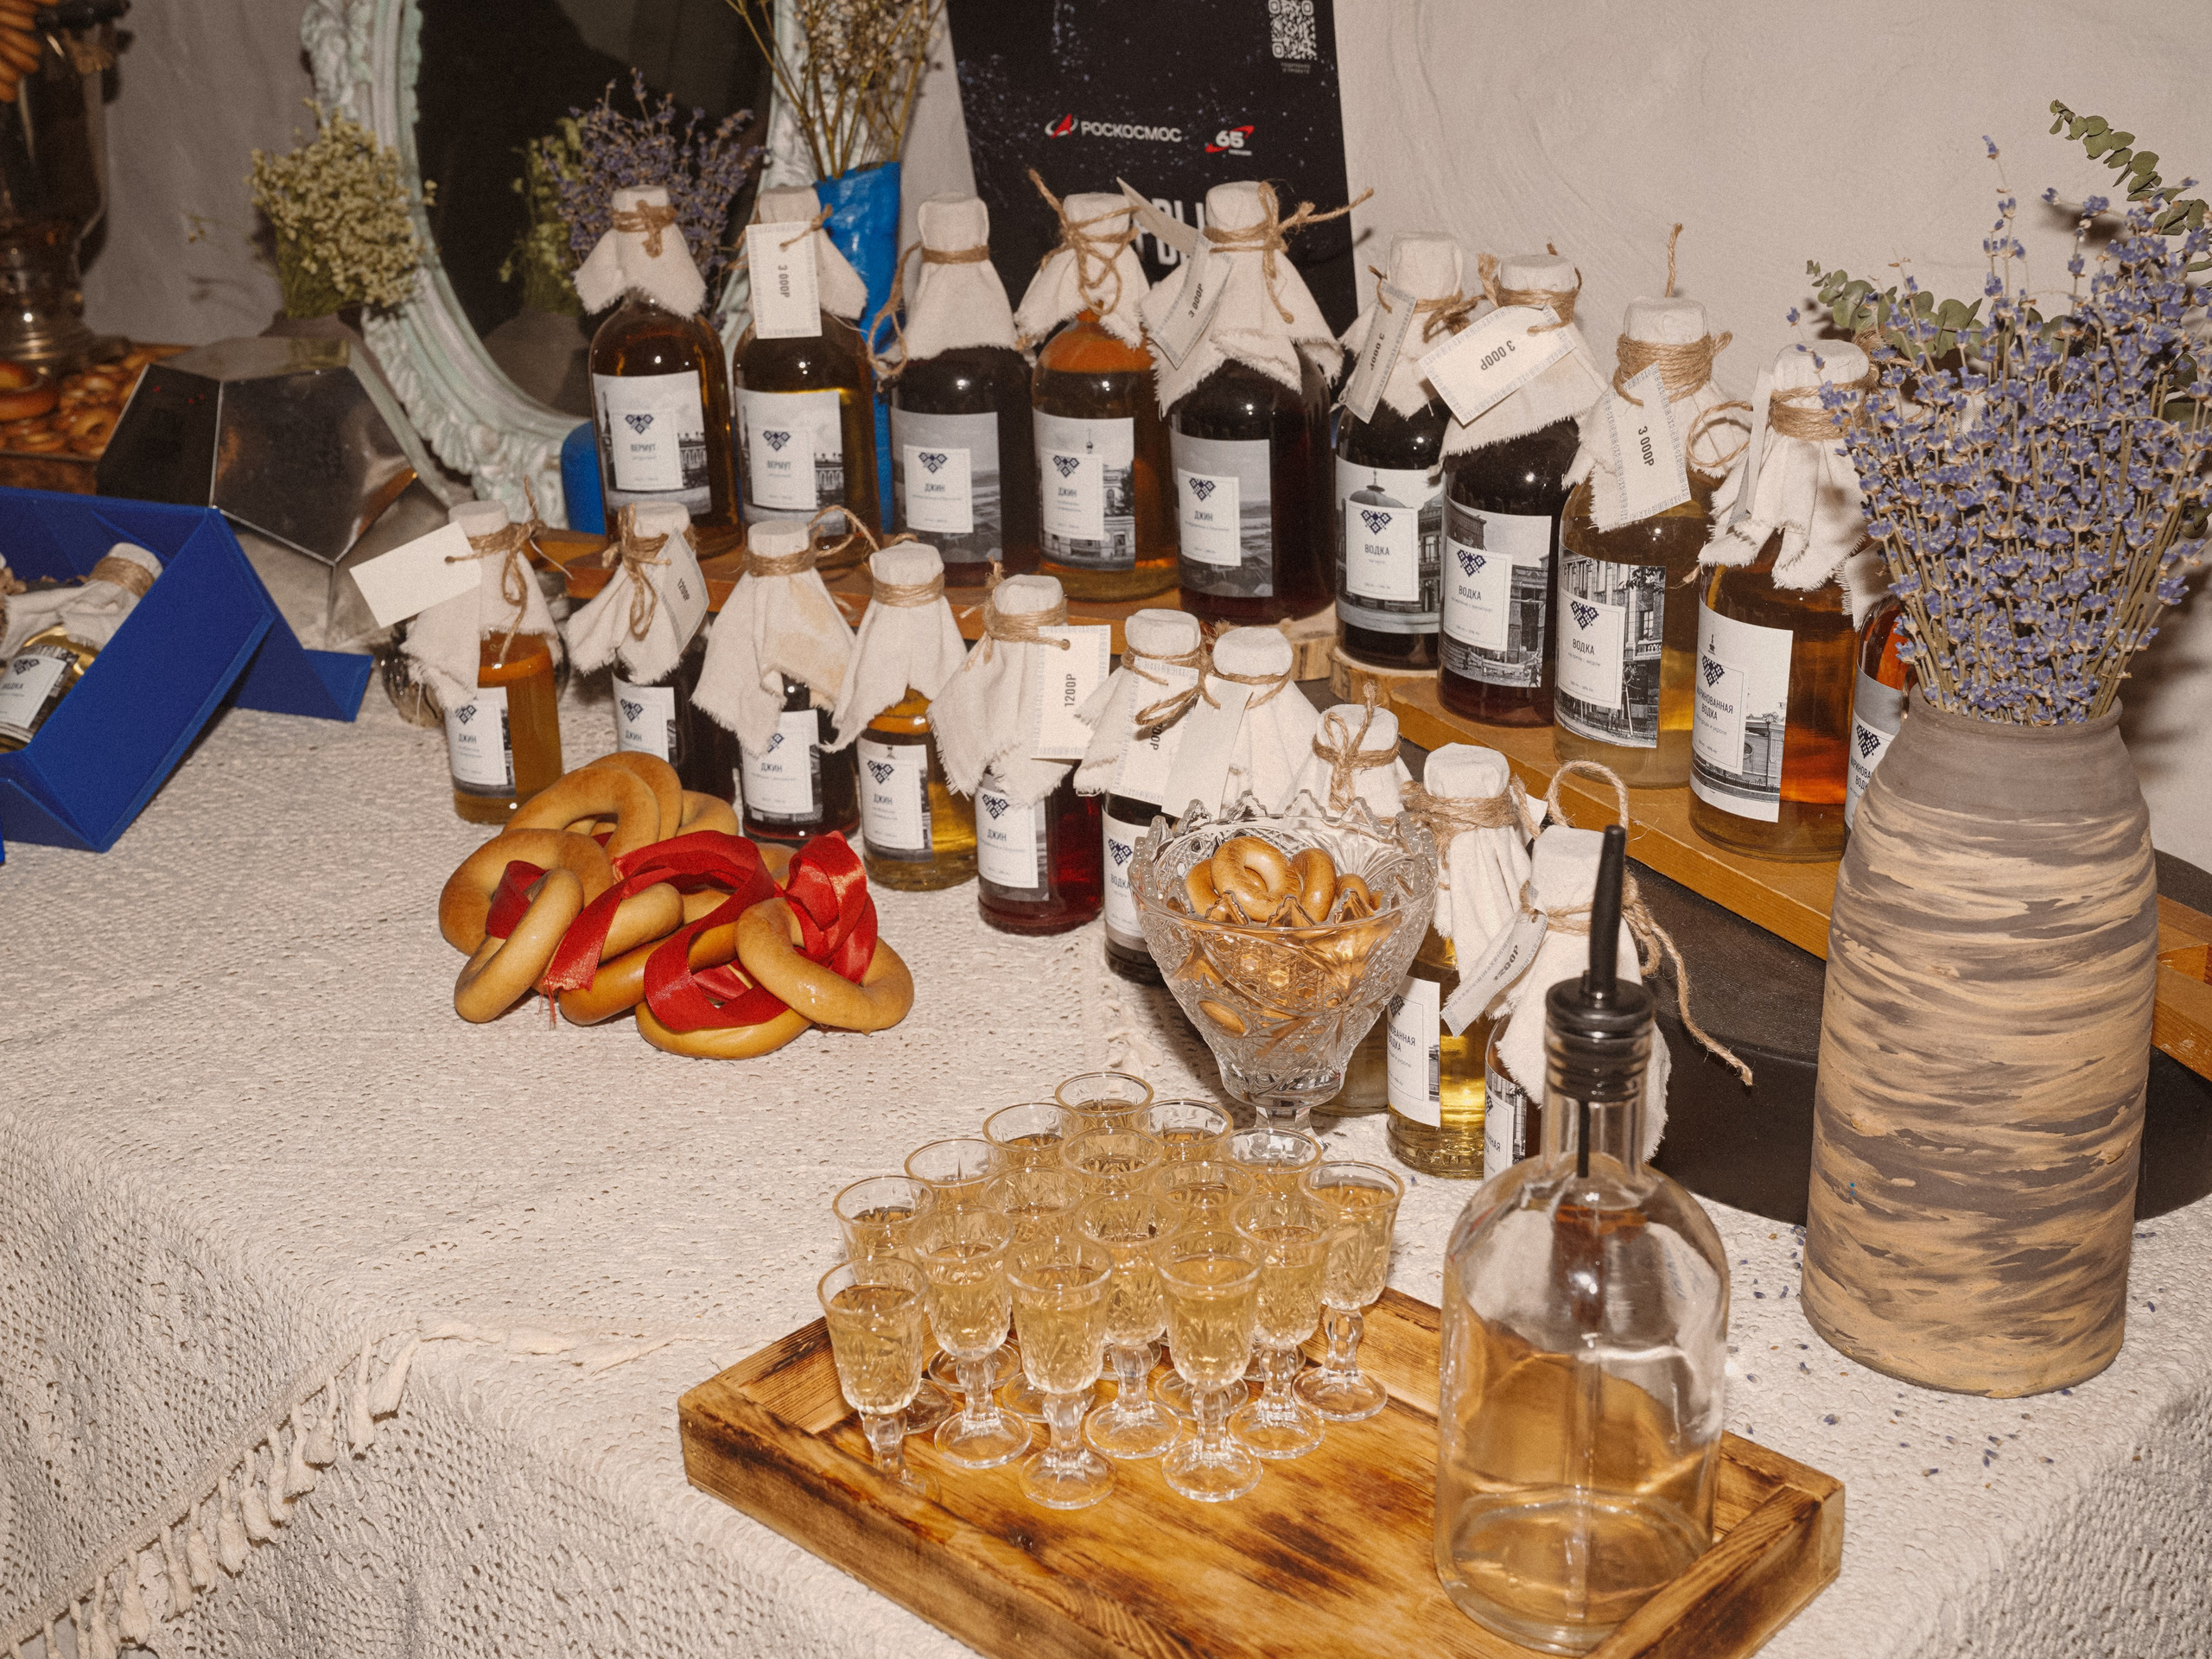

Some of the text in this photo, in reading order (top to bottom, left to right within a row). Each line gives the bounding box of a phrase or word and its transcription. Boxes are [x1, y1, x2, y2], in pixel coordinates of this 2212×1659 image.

[1080, 121, 1182, 143] РОСКОСМОС
[1215, 130, 1245, 149] 65
[779, 274, 790, 297] 000Р
[1480, 340, 1516, 371] 3 000Р
[1637, 425, 1655, 467] 3 000Р
[1194, 511, 1213, 522] ДЖИН
[1364, 544, 1390, 556] ВОДКА
[1459, 585, 1482, 601] ВОДКА
[1573, 638, 1595, 655] ВОДКА
[1065, 674, 1077, 707] 1200Р
[1701, 703, 1718, 721] ВОДКА
[1149, 722, 1163, 751] 00Р
[760, 762, 782, 772] ДЖИН
[1855, 775, 1869, 791] ВОДК
[988, 829, 1007, 842] ДЖИН
